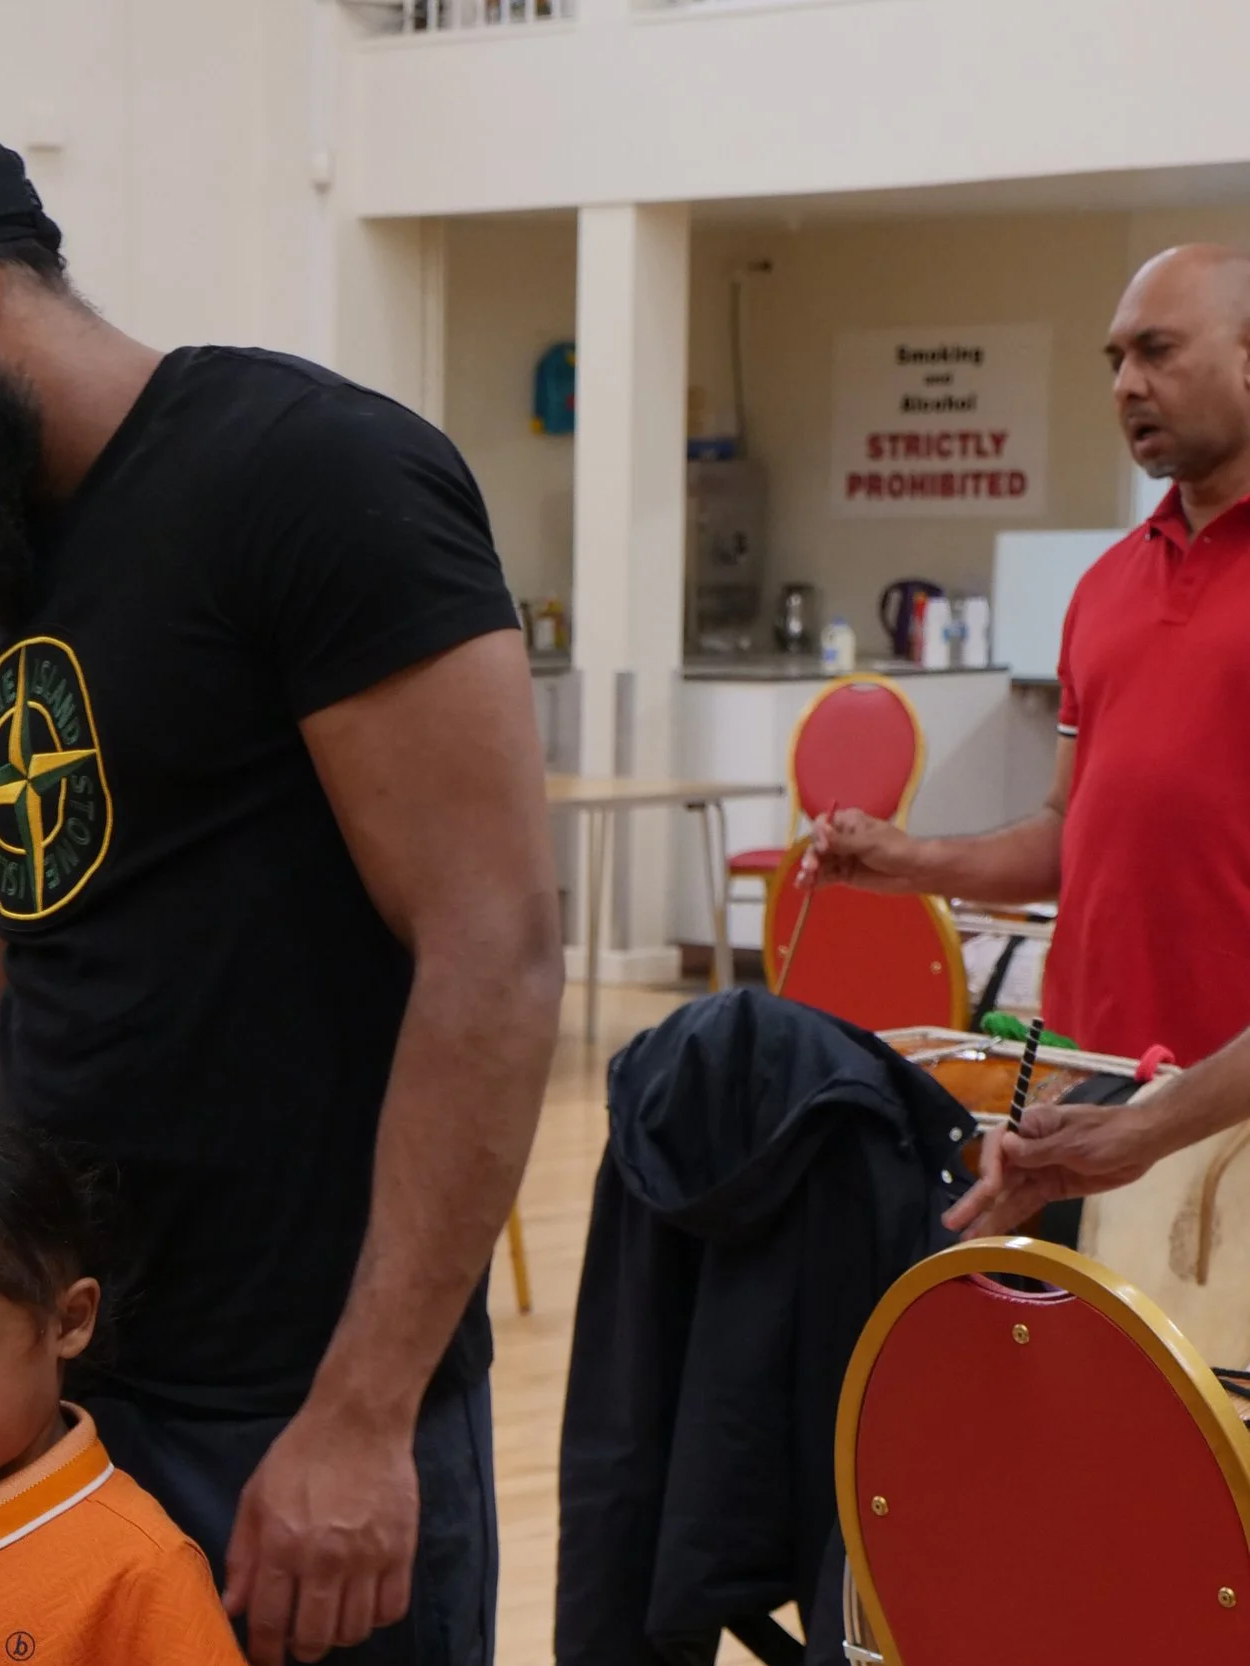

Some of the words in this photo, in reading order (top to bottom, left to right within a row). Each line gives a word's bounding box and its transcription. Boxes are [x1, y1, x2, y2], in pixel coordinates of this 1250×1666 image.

[898, 345, 984, 366] Smoking
[902, 394, 976, 413] Alcohol
[868, 432, 1008, 460] STRICTLY
[848, 471, 1027, 499] PROHIBITED
[30, 658, 81, 746] ISLAND
